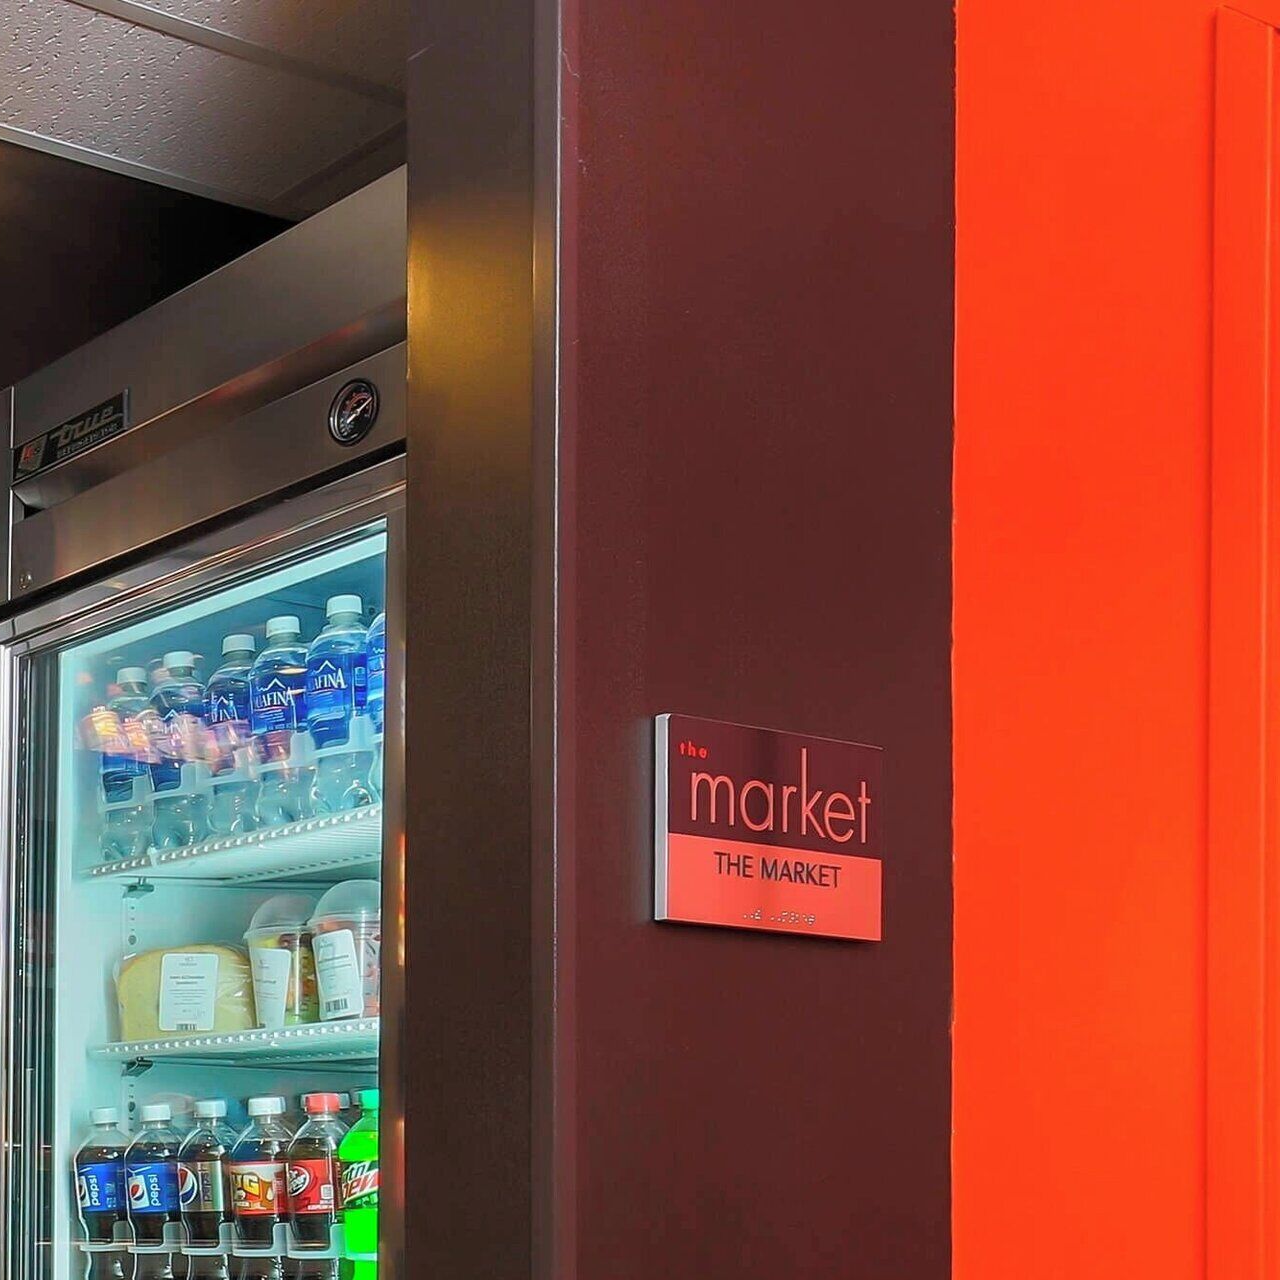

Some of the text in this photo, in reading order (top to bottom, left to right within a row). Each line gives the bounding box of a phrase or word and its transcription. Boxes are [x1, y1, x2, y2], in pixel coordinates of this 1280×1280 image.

[691, 748, 872, 845] market
[714, 851, 842, 889] THE MARKET
[90, 1173, 101, 1206] pepsi
[149, 1173, 161, 1207] pepsi
